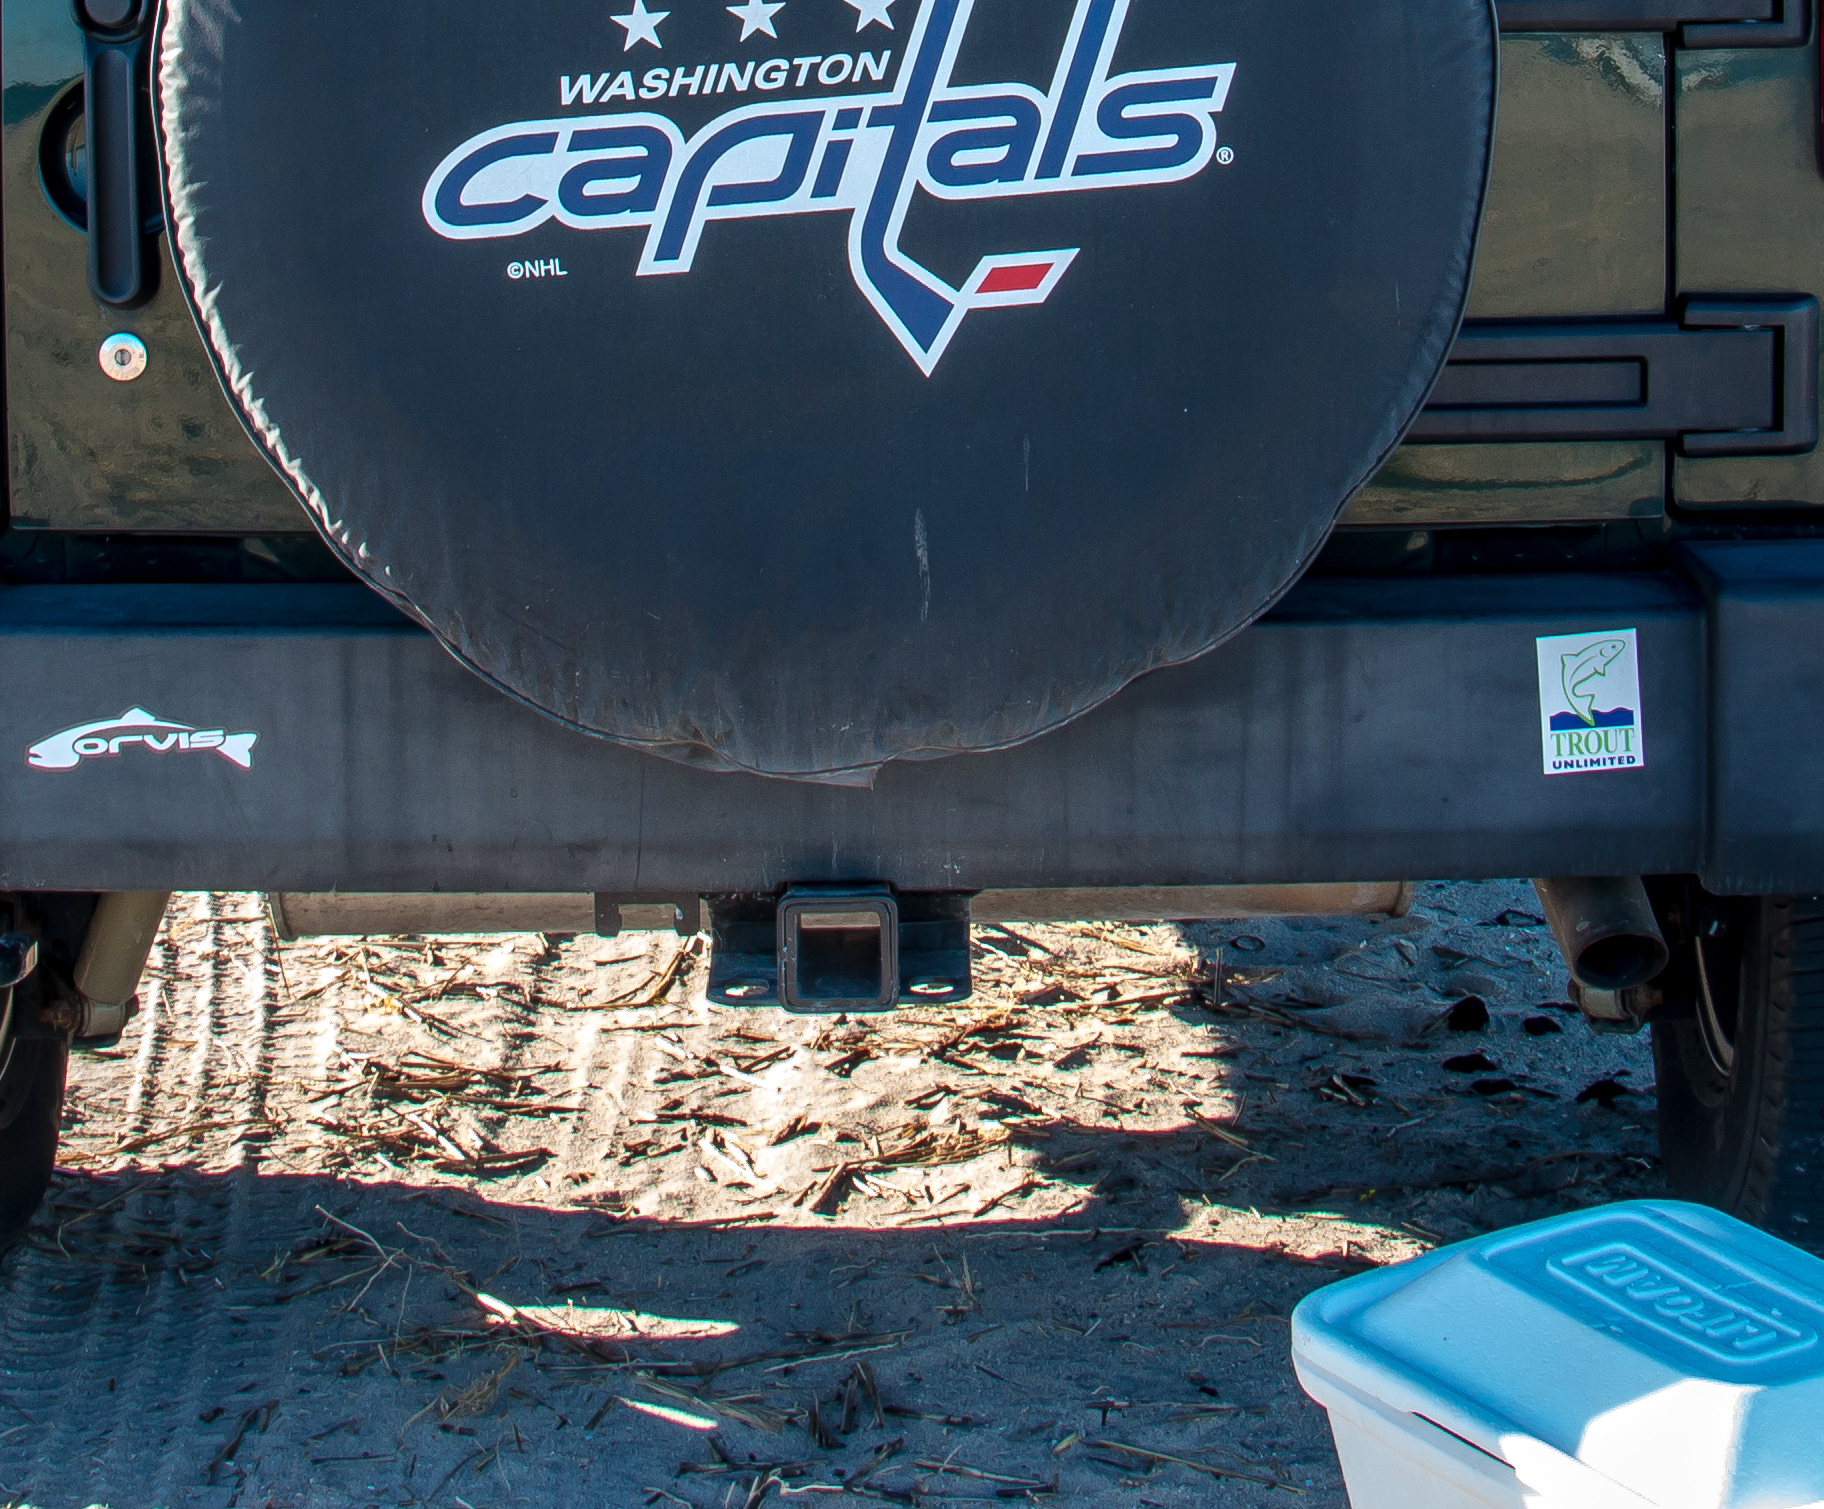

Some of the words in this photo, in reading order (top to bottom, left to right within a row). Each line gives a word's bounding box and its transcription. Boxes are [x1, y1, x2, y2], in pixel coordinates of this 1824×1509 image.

[560, 50, 892, 106] WASHINGTON
[1550, 727, 1636, 758] TROUT
[1552, 755, 1636, 770] UNLIMITED
